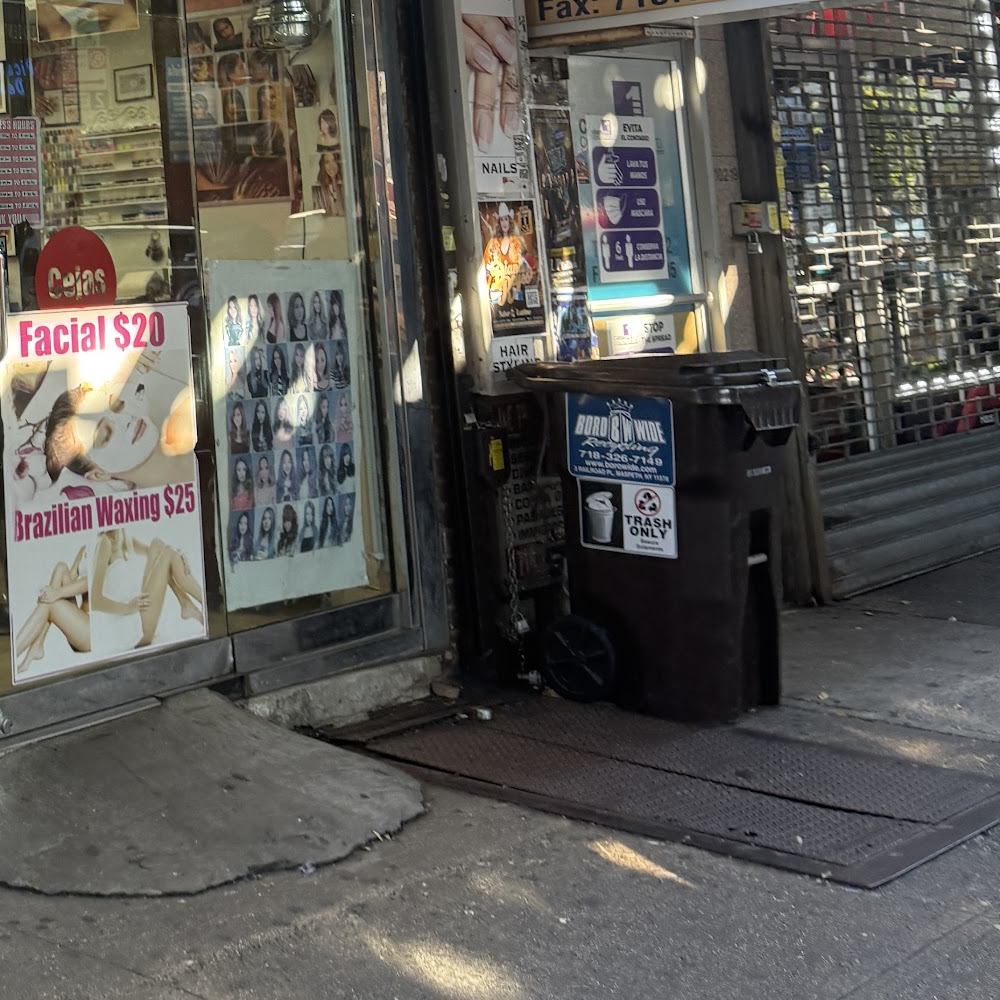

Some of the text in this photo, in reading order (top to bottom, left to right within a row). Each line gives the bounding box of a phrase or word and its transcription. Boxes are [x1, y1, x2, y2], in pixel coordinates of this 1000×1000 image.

[623, 123, 643, 133] EVITA
[482, 162, 518, 174] NAILS
[47, 265, 107, 300] Cejas
[19, 310, 165, 358] Facial $20
[500, 344, 529, 357] HAIR
[575, 413, 608, 438] BORO
[634, 418, 667, 444] WIDE
[579, 449, 663, 467] 718-326-7149
[14, 483, 195, 542] Brazilian Waxing $25
[624, 515, 672, 530] TRASH
[629, 526, 667, 540] ONLY
